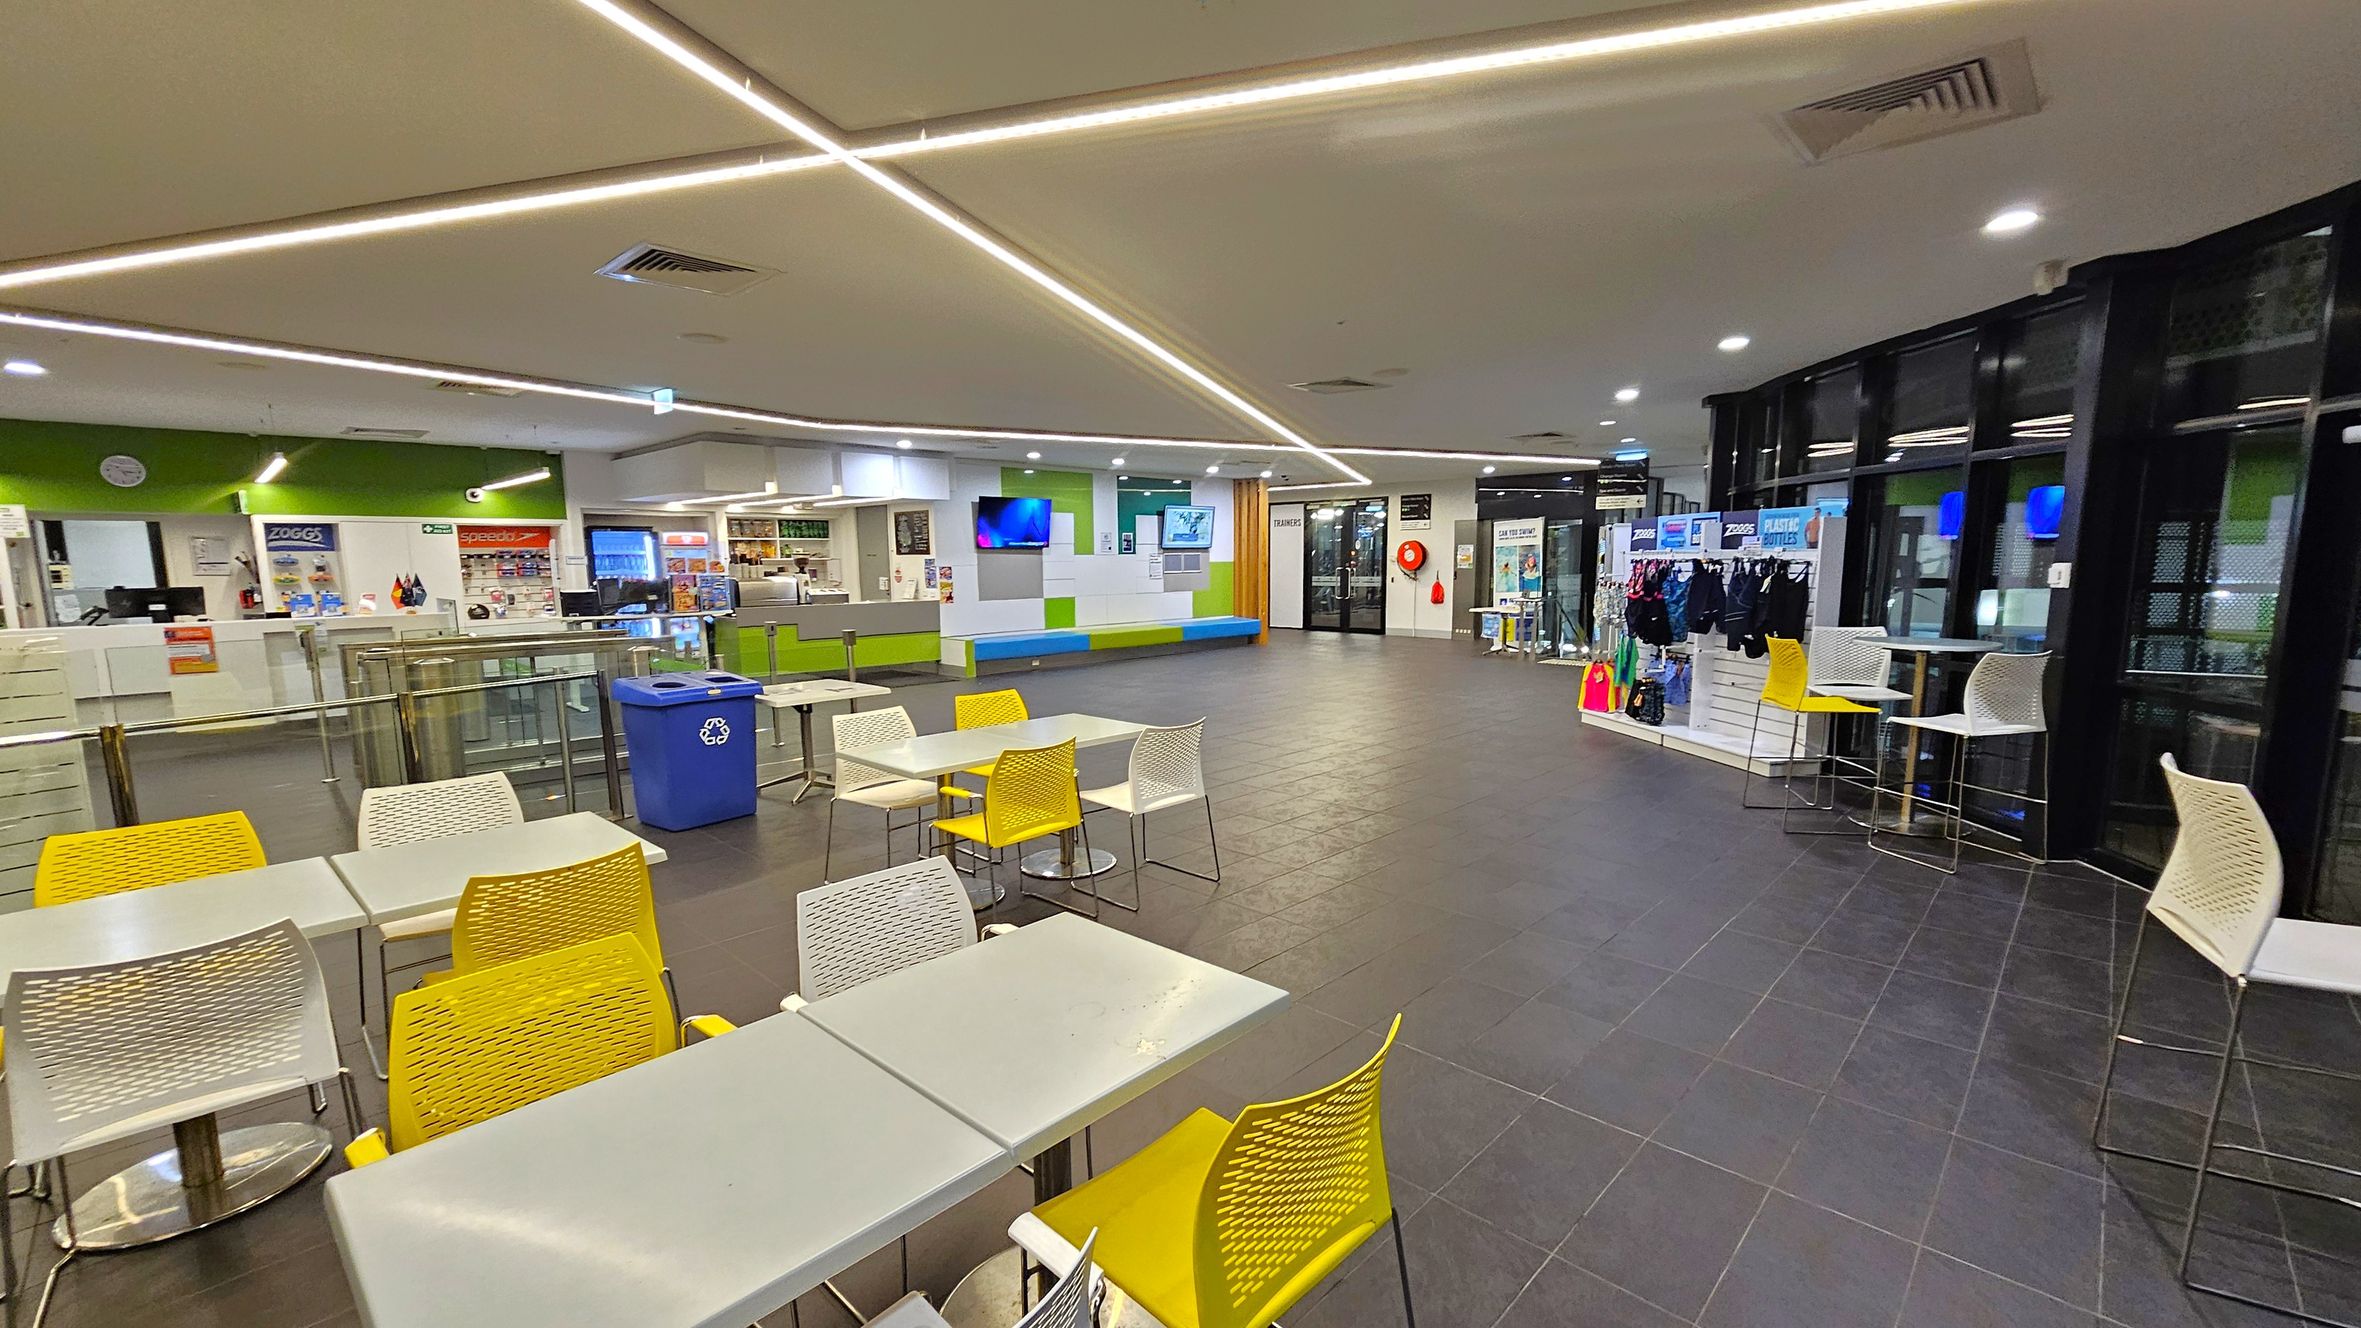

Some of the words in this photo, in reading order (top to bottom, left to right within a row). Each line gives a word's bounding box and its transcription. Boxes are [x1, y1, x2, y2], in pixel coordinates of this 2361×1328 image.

[1274, 518, 1302, 527] TRAINERS
[267, 527, 323, 542] ZOGGS
[1631, 528, 1657, 540] ZOGGS
[1722, 523, 1756, 537] ZOGGS
[460, 531, 516, 544] speedo
[1763, 532, 1799, 546] BOTTLES
